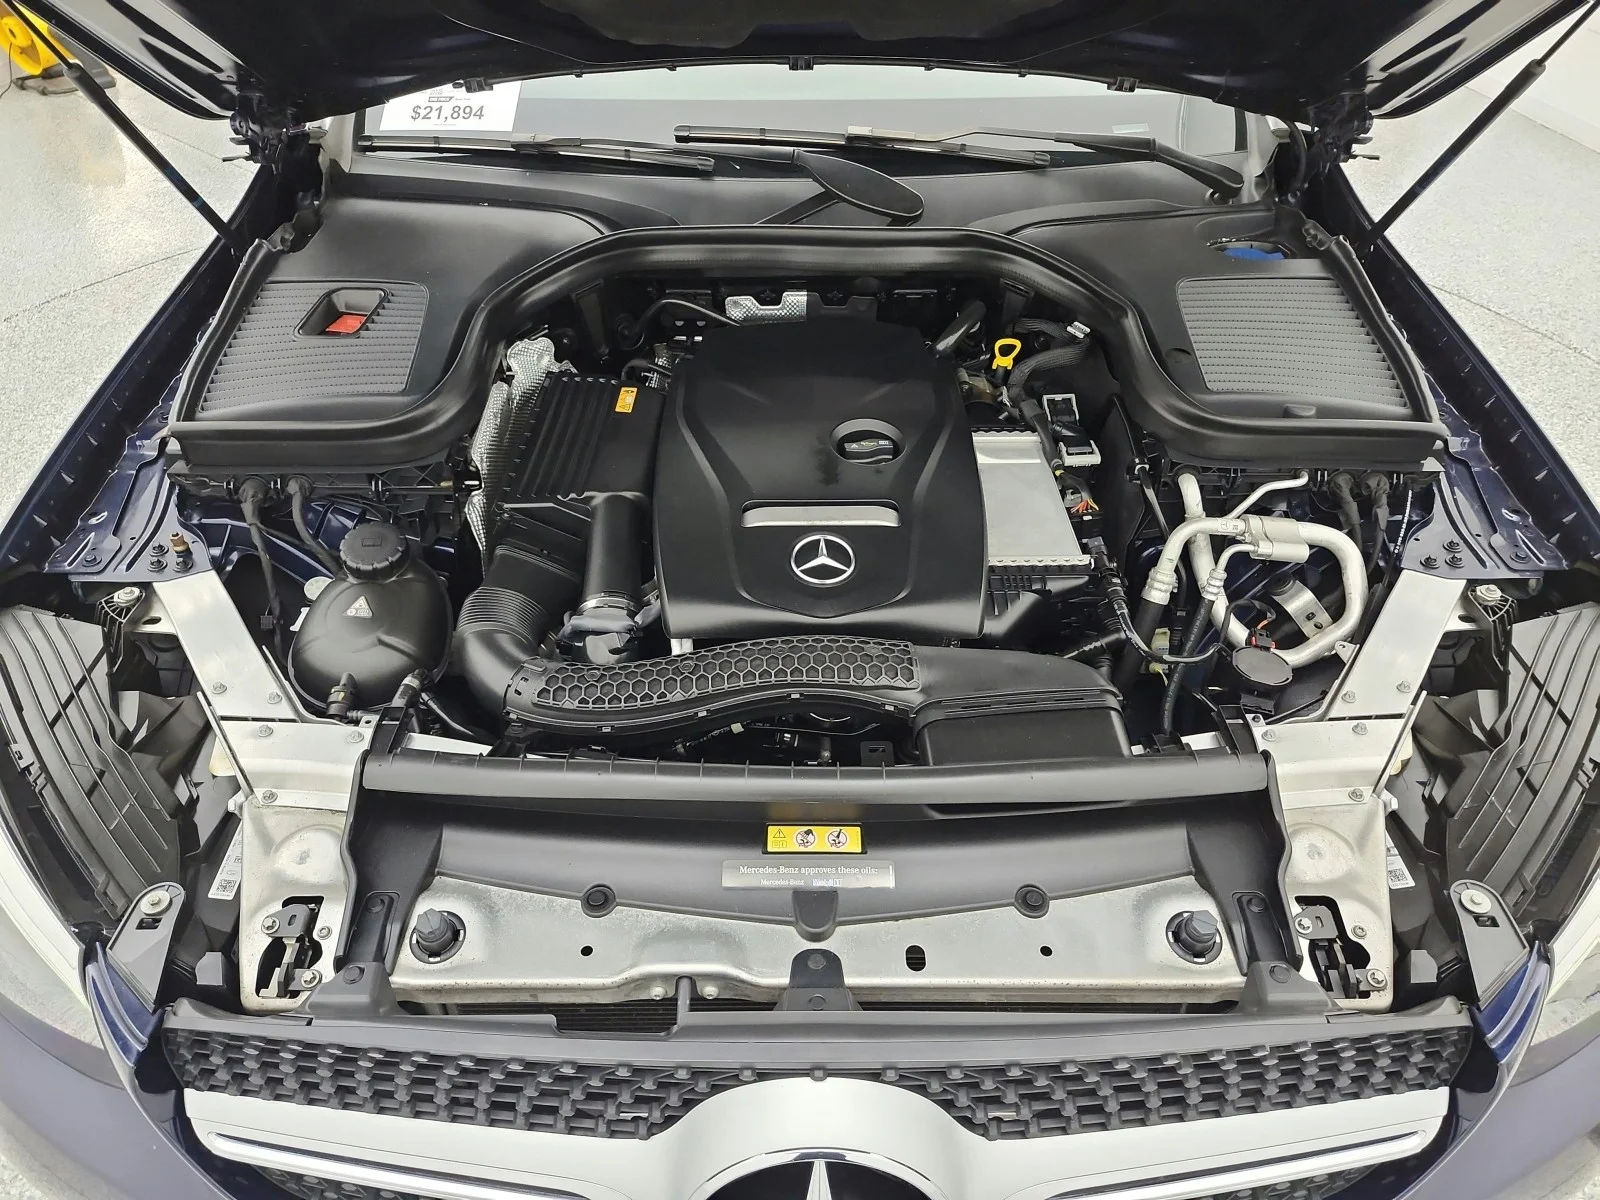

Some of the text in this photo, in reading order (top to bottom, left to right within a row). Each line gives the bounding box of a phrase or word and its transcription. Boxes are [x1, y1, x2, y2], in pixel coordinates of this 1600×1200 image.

[410, 105, 485, 122] $21,894
[739, 865, 799, 874] Mercedes-Benz
[800, 866, 836, 875] approves
[838, 865, 860, 874] these
